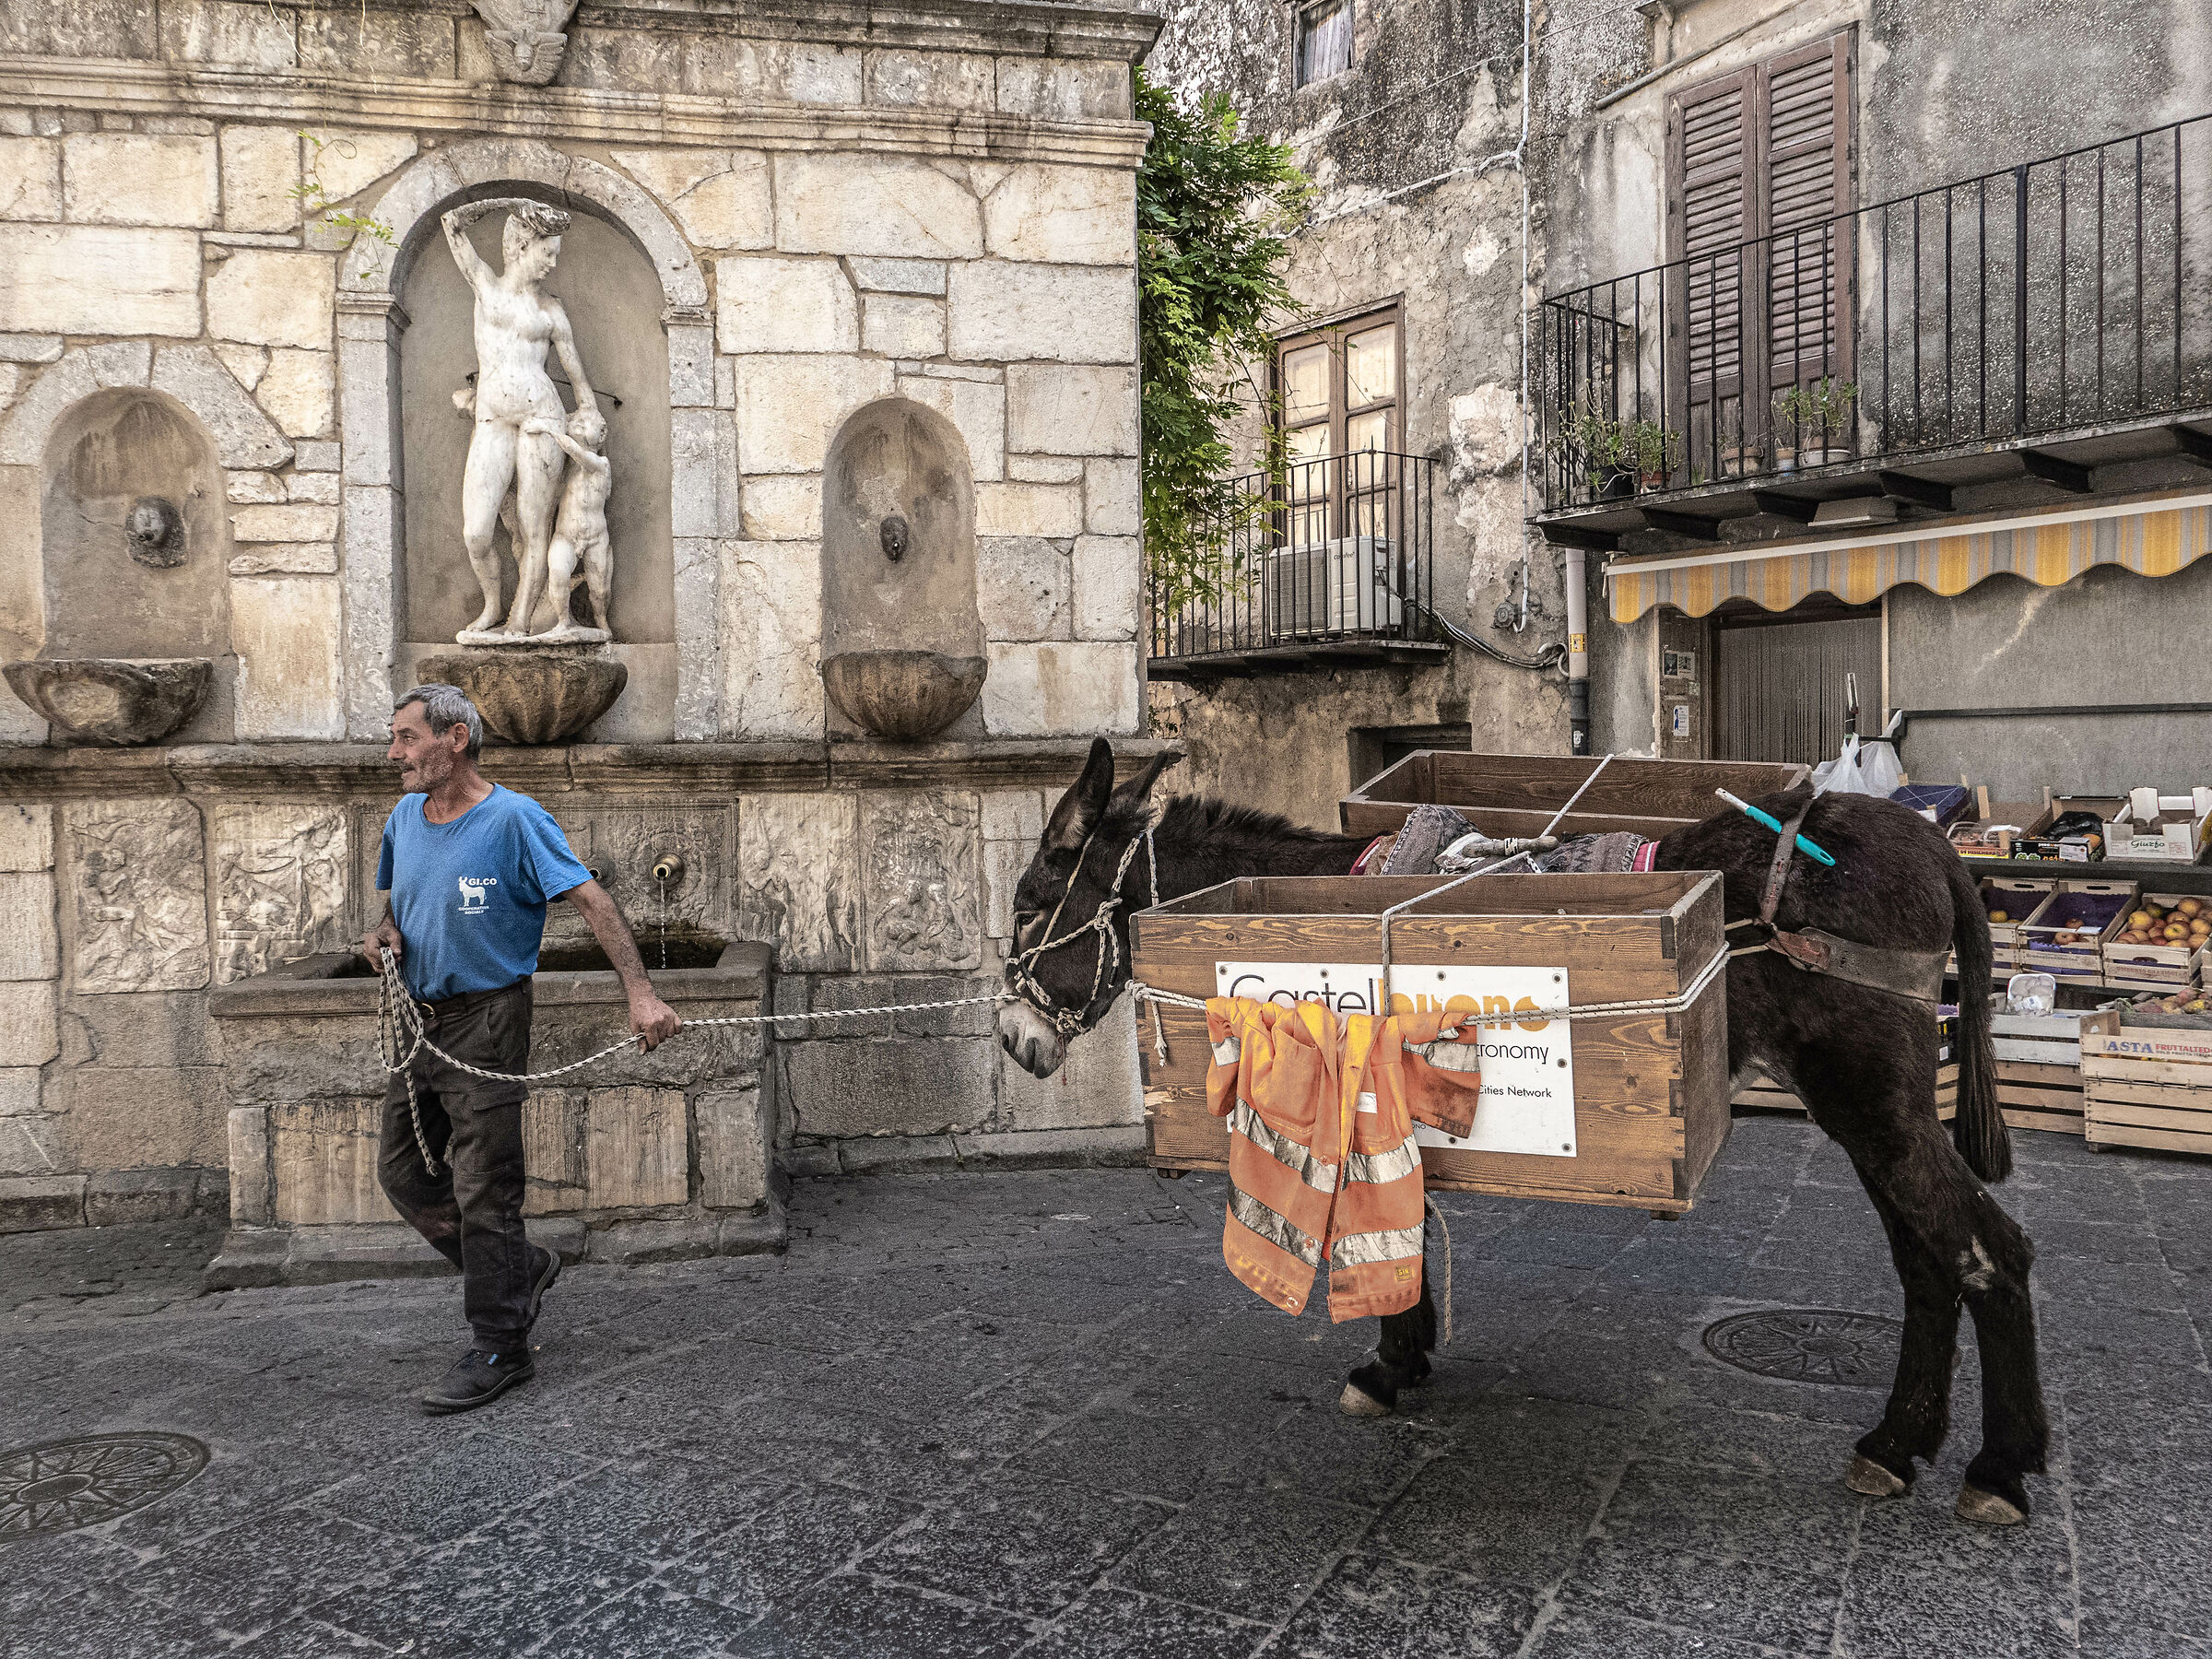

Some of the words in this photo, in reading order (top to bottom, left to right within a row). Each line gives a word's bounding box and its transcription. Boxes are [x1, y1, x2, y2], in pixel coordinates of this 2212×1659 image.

[468, 877, 498, 886] GI.CO
[2107, 1041, 2154, 1054] ASTA
[1479, 1084, 1504, 1096] Cities
[1507, 1086, 1552, 1098] Network
